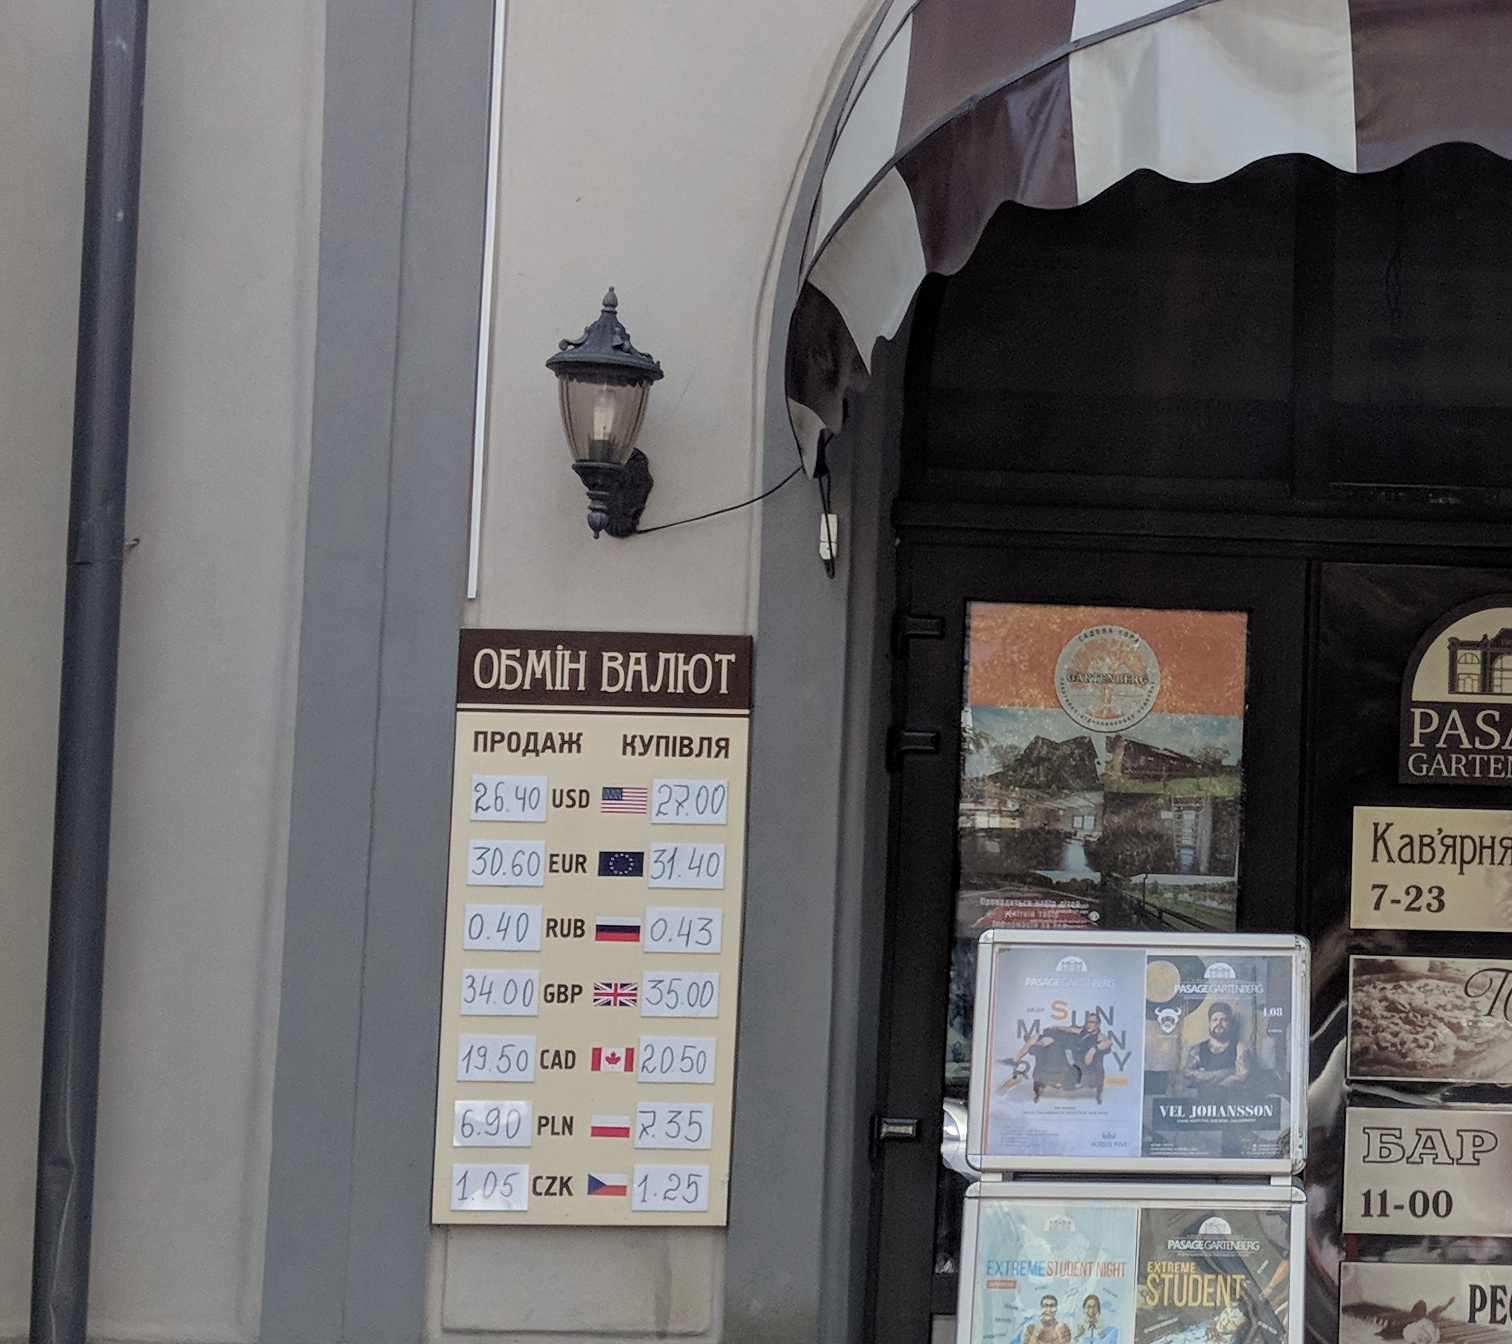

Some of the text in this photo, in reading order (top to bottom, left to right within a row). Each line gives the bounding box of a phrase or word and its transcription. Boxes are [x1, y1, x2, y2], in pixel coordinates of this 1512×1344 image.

[473, 644, 736, 694] ОБМІН ВАЛЮТ
[1066, 671, 1150, 686] GARTENBERG
[473, 731, 730, 759] ПРОДАЖ КУПІВЛЯ
[473, 781, 727, 817] 26.40 USD 27.00
[472, 846, 721, 880] 30.60 EUR 31.40
[1370, 883, 1446, 913] 7-23
[468, 911, 714, 947] 0.40 RUB 0.43
[464, 974, 715, 1009] 34.00 GBP 35.00
[461, 1043, 529, 1074] 19.50
[540, 1049, 577, 1070] CAD
[461, 1107, 703, 1143] 6.90 PLN 7.35
[1159, 1104, 1274, 1118] VEL JOHANSSON
[1362, 1127, 1498, 1166] БАР
[456, 1169, 702, 1204] 1.05 CZK 1.25
[1361, 1189, 1453, 1218] 11-00
[986, 1260, 1127, 1278] EXTREME STUDENT NIGHT
[1147, 1261, 1197, 1273] EXTREME
[1145, 1273, 1245, 1307] STUDENT
